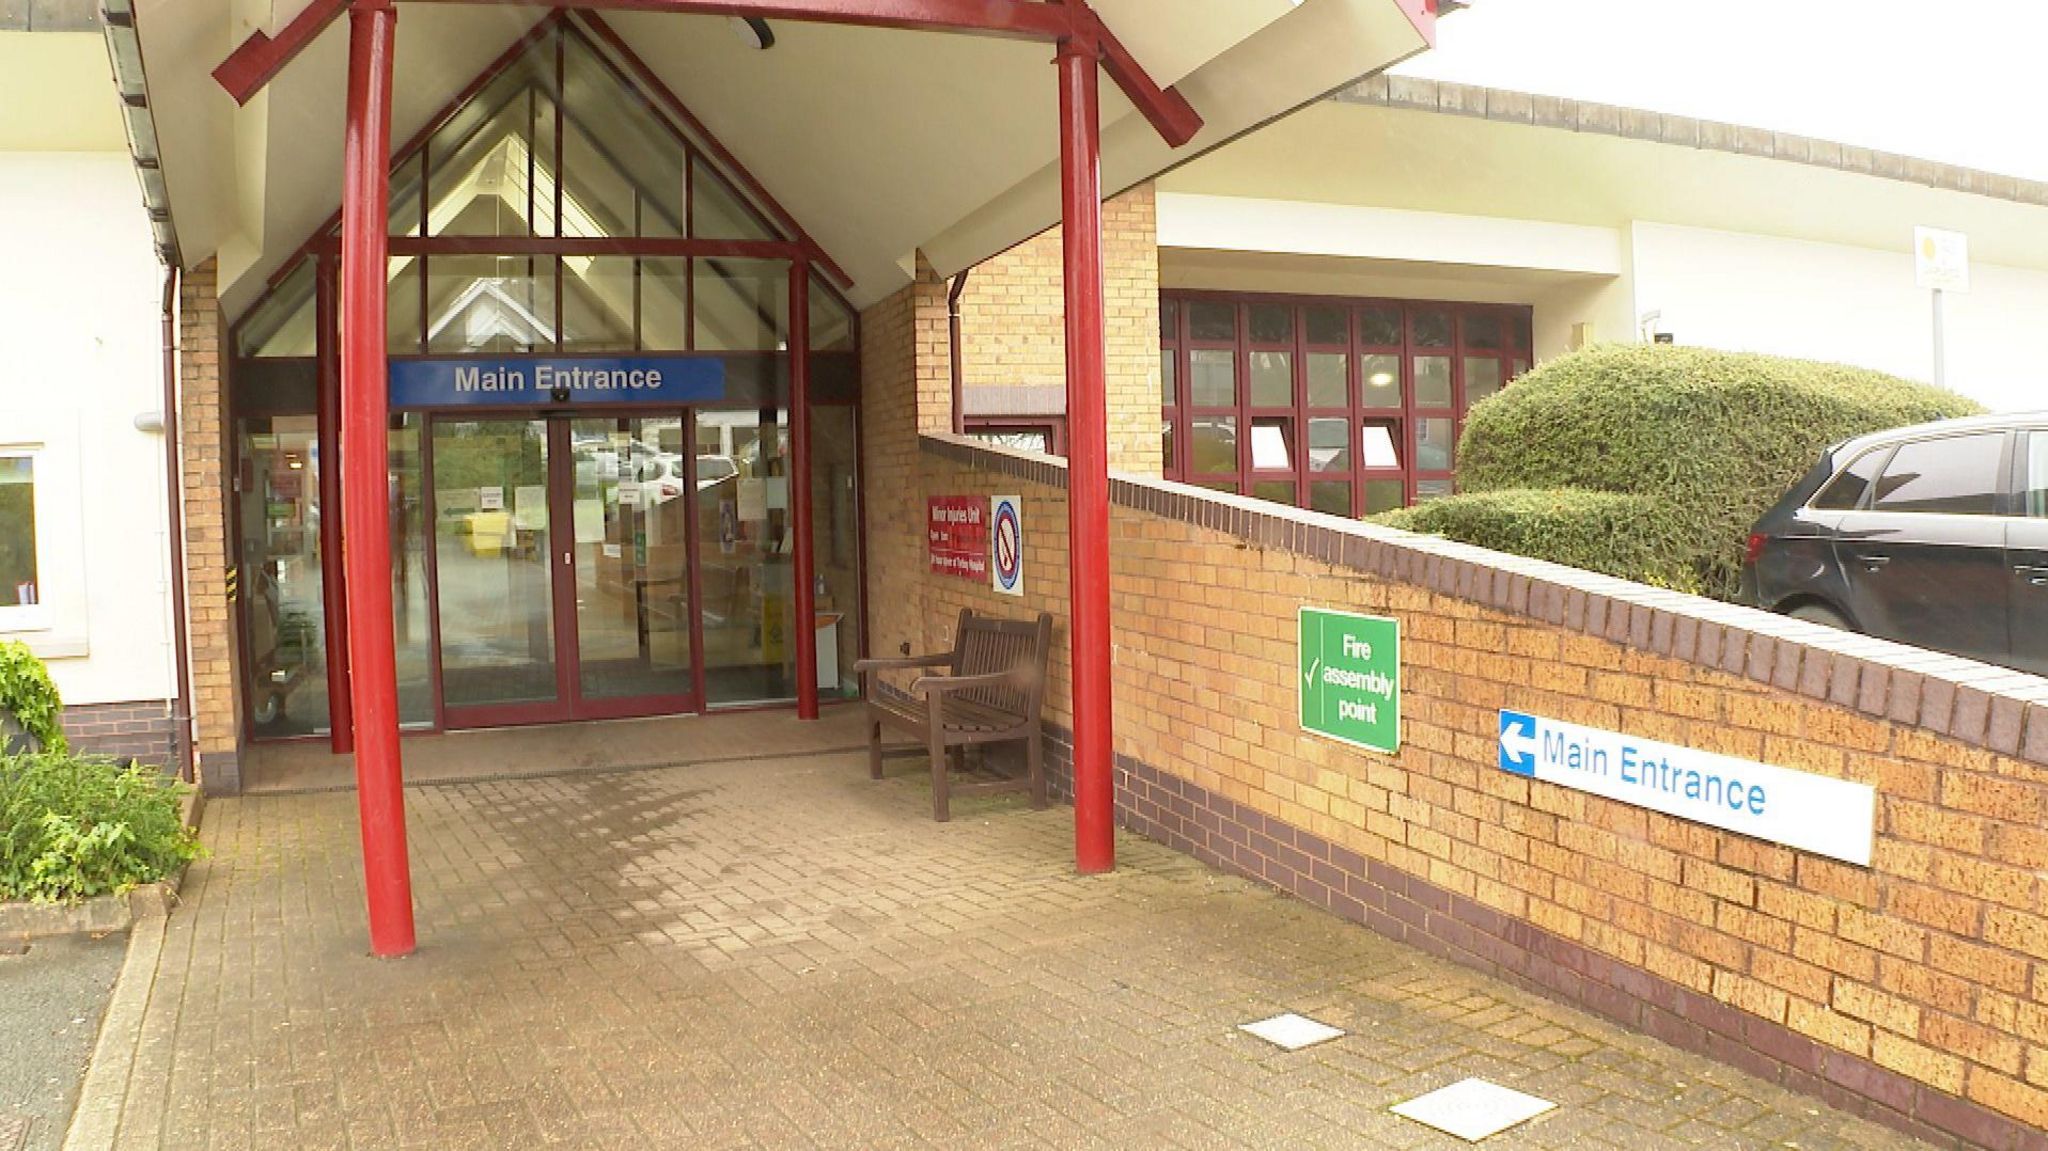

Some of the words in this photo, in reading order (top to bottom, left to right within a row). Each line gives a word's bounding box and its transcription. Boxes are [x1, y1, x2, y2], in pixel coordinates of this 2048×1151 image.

[455, 366, 524, 392] Main
[535, 365, 662, 390] Entrance
[947, 506, 967, 526] Injuries
[968, 506, 980, 524] Unit
[1343, 634, 1372, 661] Fire
[1323, 665, 1394, 701] assembly
[1339, 698, 1378, 725] point
[1543, 729, 1608, 776] Main
[1621, 746, 1767, 816] Entrance
